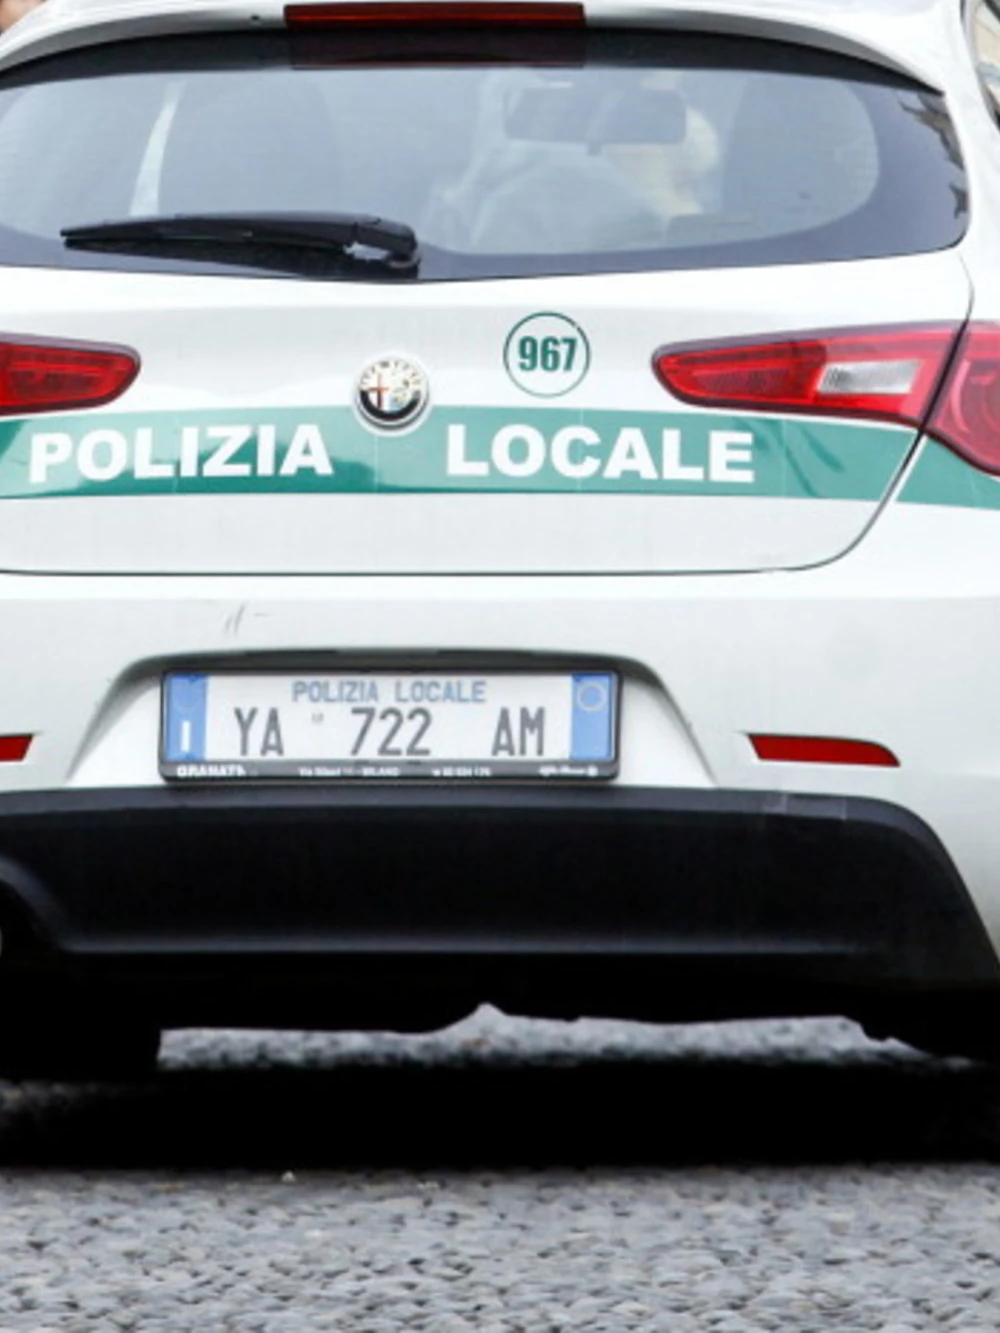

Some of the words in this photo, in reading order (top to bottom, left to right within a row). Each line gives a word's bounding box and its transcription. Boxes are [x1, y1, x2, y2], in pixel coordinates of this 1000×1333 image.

[519, 335, 577, 372] 967
[29, 424, 334, 483] POLIZIA
[446, 424, 754, 483] LOCALE
[292, 681, 379, 702] POLIZIA
[395, 681, 487, 702] LOCALE
[234, 707, 284, 756] YA
[350, 707, 432, 756] 722
[491, 707, 545, 756] AM
